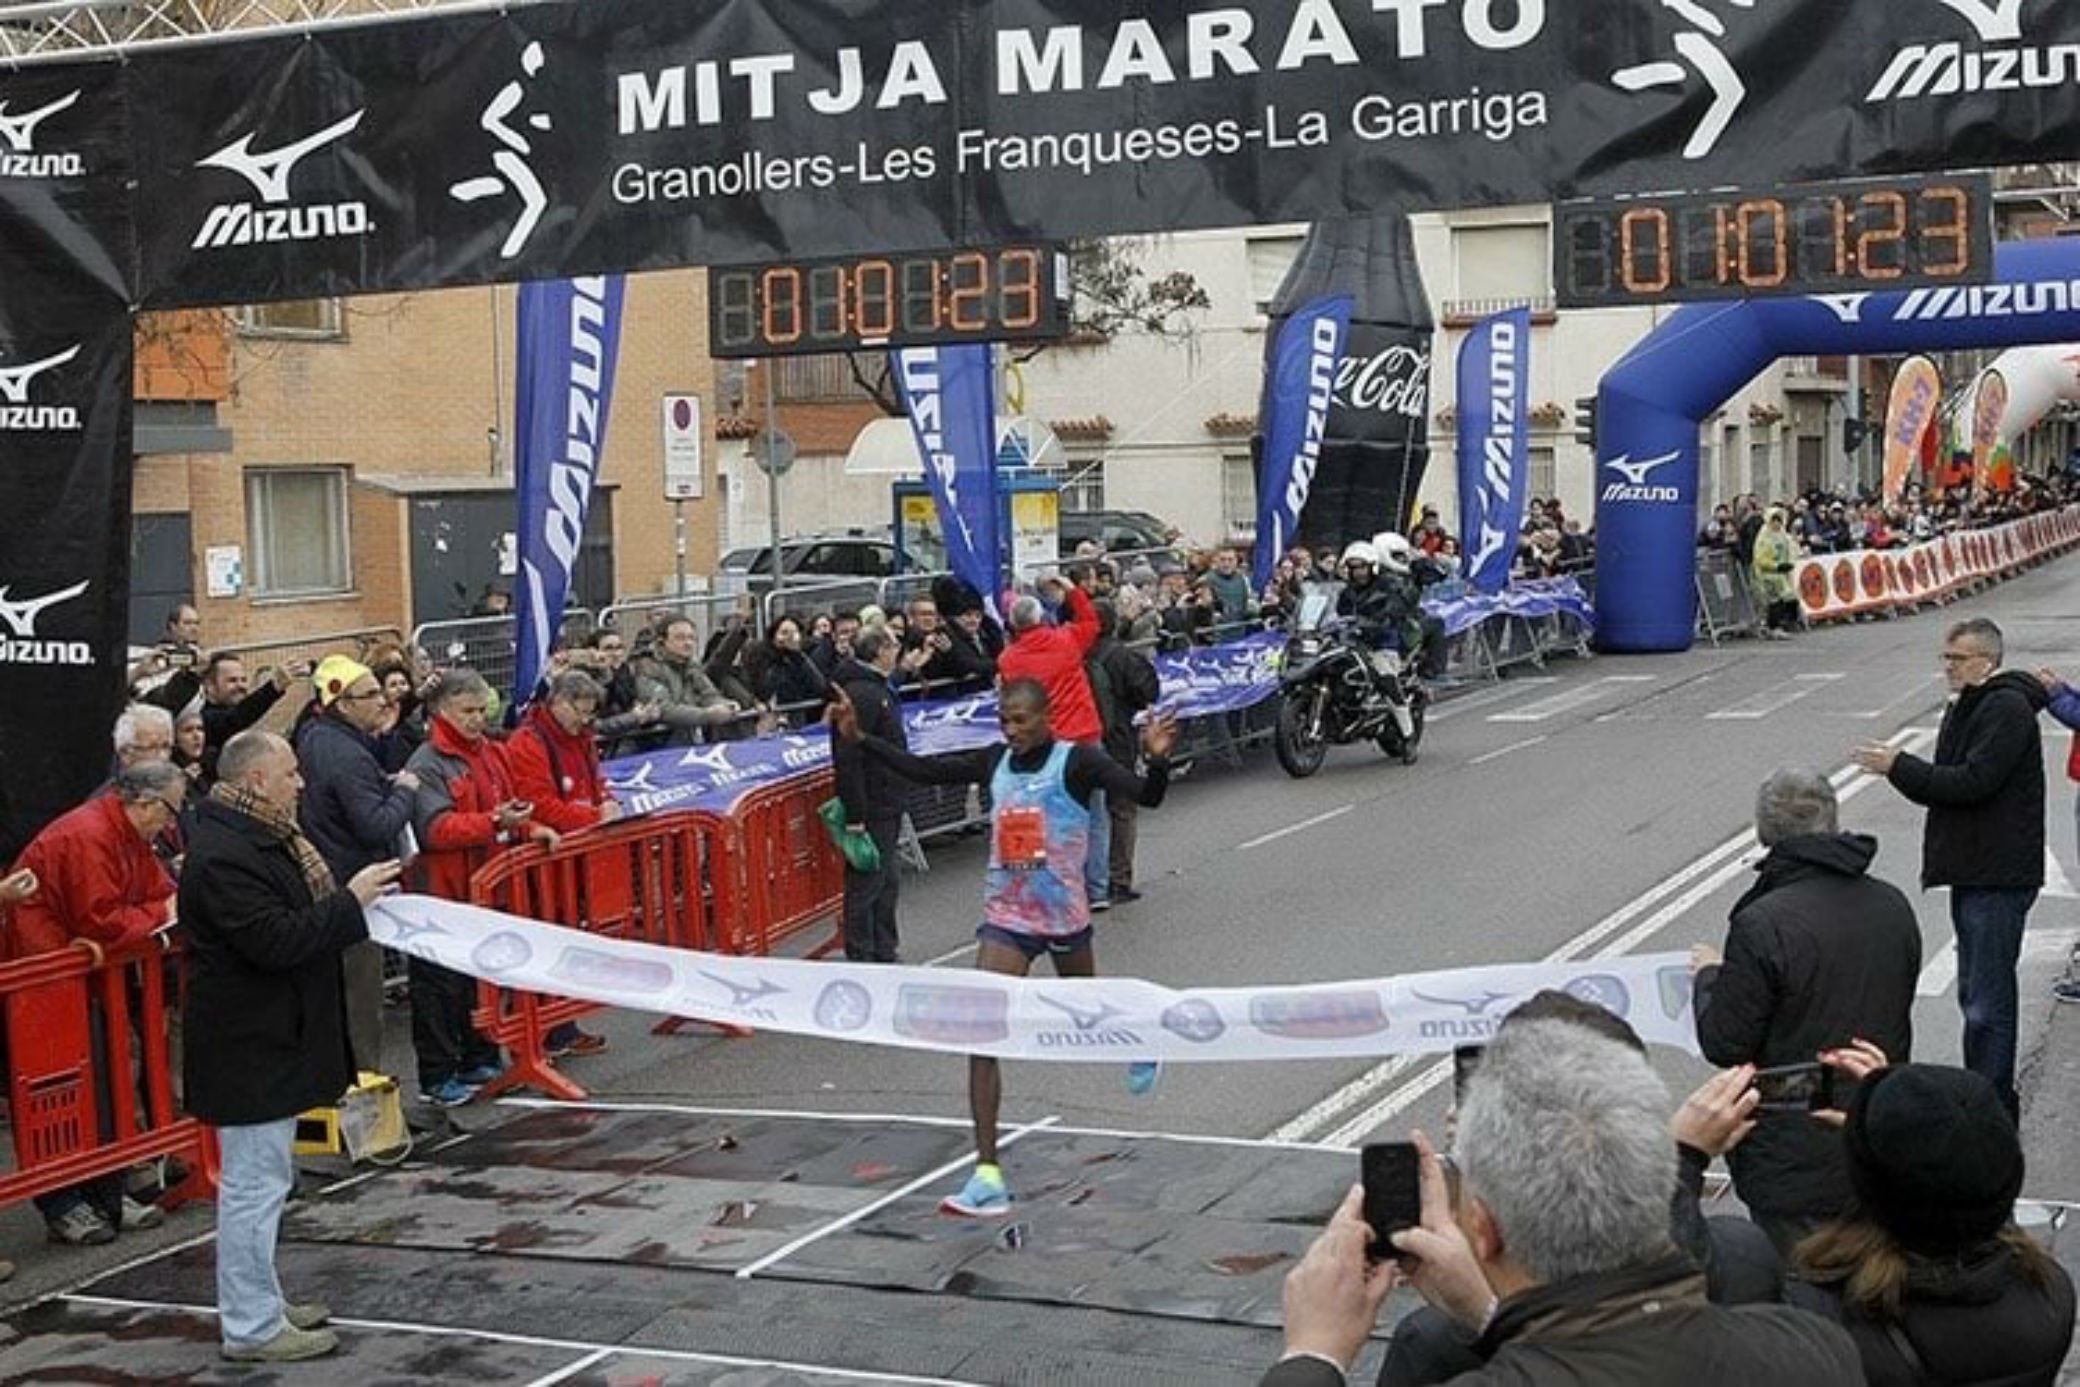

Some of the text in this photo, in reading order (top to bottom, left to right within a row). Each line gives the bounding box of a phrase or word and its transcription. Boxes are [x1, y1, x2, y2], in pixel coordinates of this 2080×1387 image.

[618, 41, 947, 134] MITJA
[1866, 42, 2080, 101] MIZUN
[0, 152, 86, 177] IZUNO
[612, 86, 1547, 203] Granollers-Les Franqueses-La Garriga
[0, 406, 82, 429] IZUNO
[1483, 321, 1516, 503] MIZUNO
[0, 633, 95, 664] IZUNO
